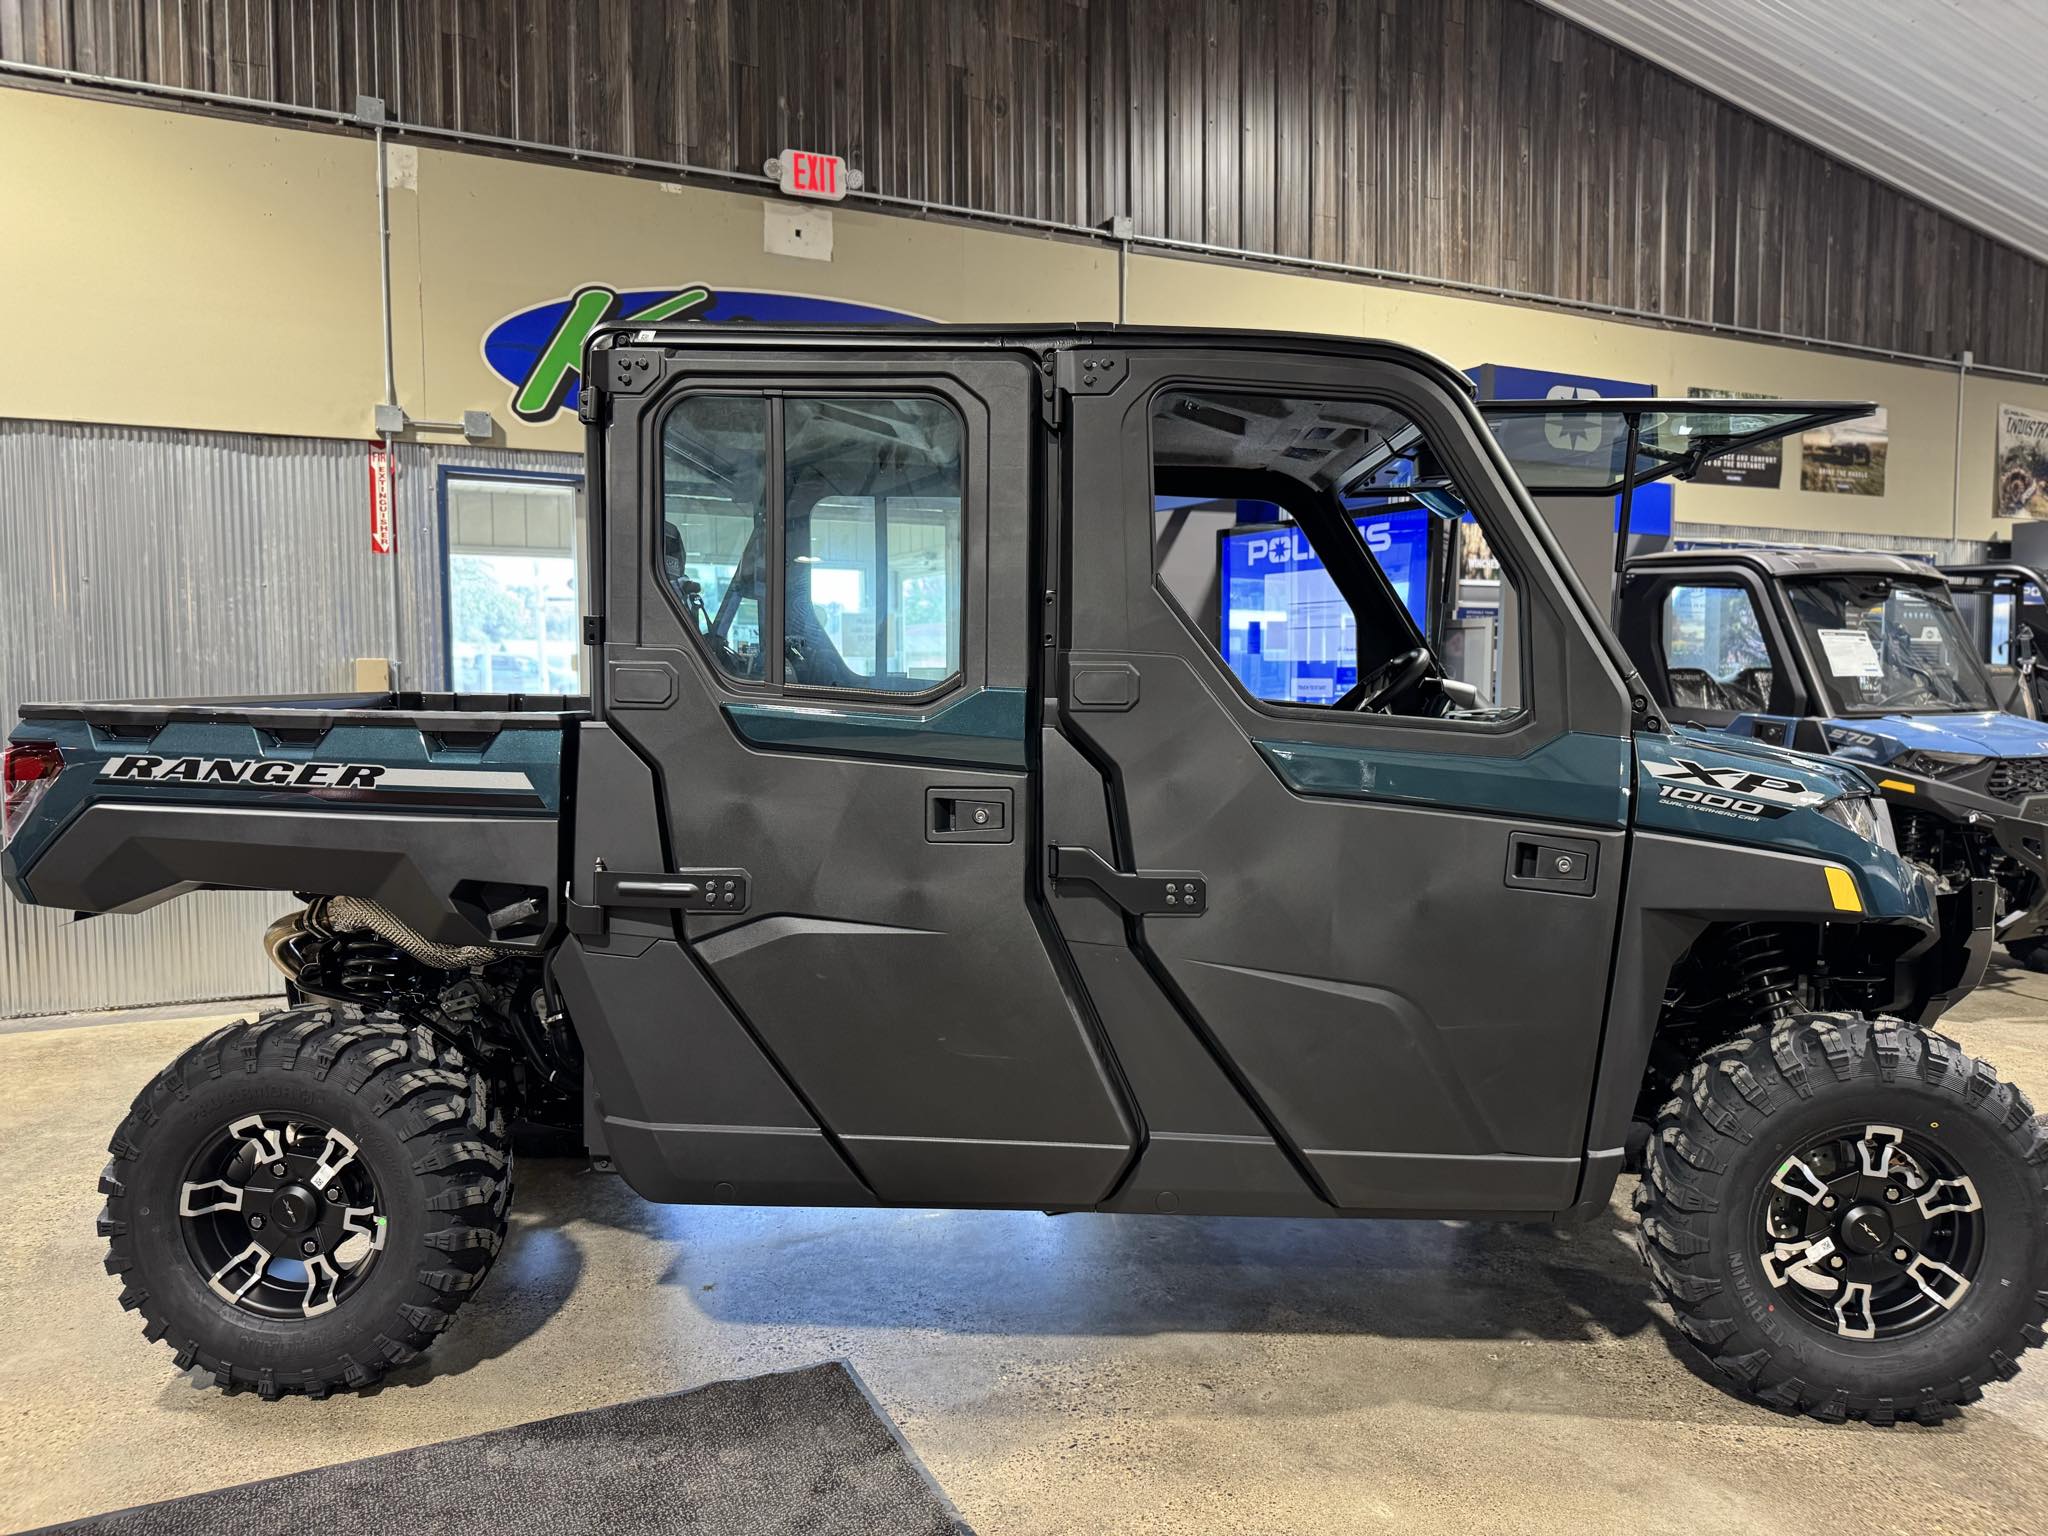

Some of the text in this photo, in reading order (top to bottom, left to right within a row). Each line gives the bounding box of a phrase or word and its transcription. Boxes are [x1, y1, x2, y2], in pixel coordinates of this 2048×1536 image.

[793, 152, 837, 193] EXIT
[2006, 417, 2048, 439] INDUSTR
[379, 466, 389, 544] EXTINGUISHER
[115, 755, 388, 790] RANGER
[1656, 758, 1808, 795] XP
[1659, 784, 1765, 816] 1000
[1659, 799, 1760, 822] DUAL OVERHEAD CAM
